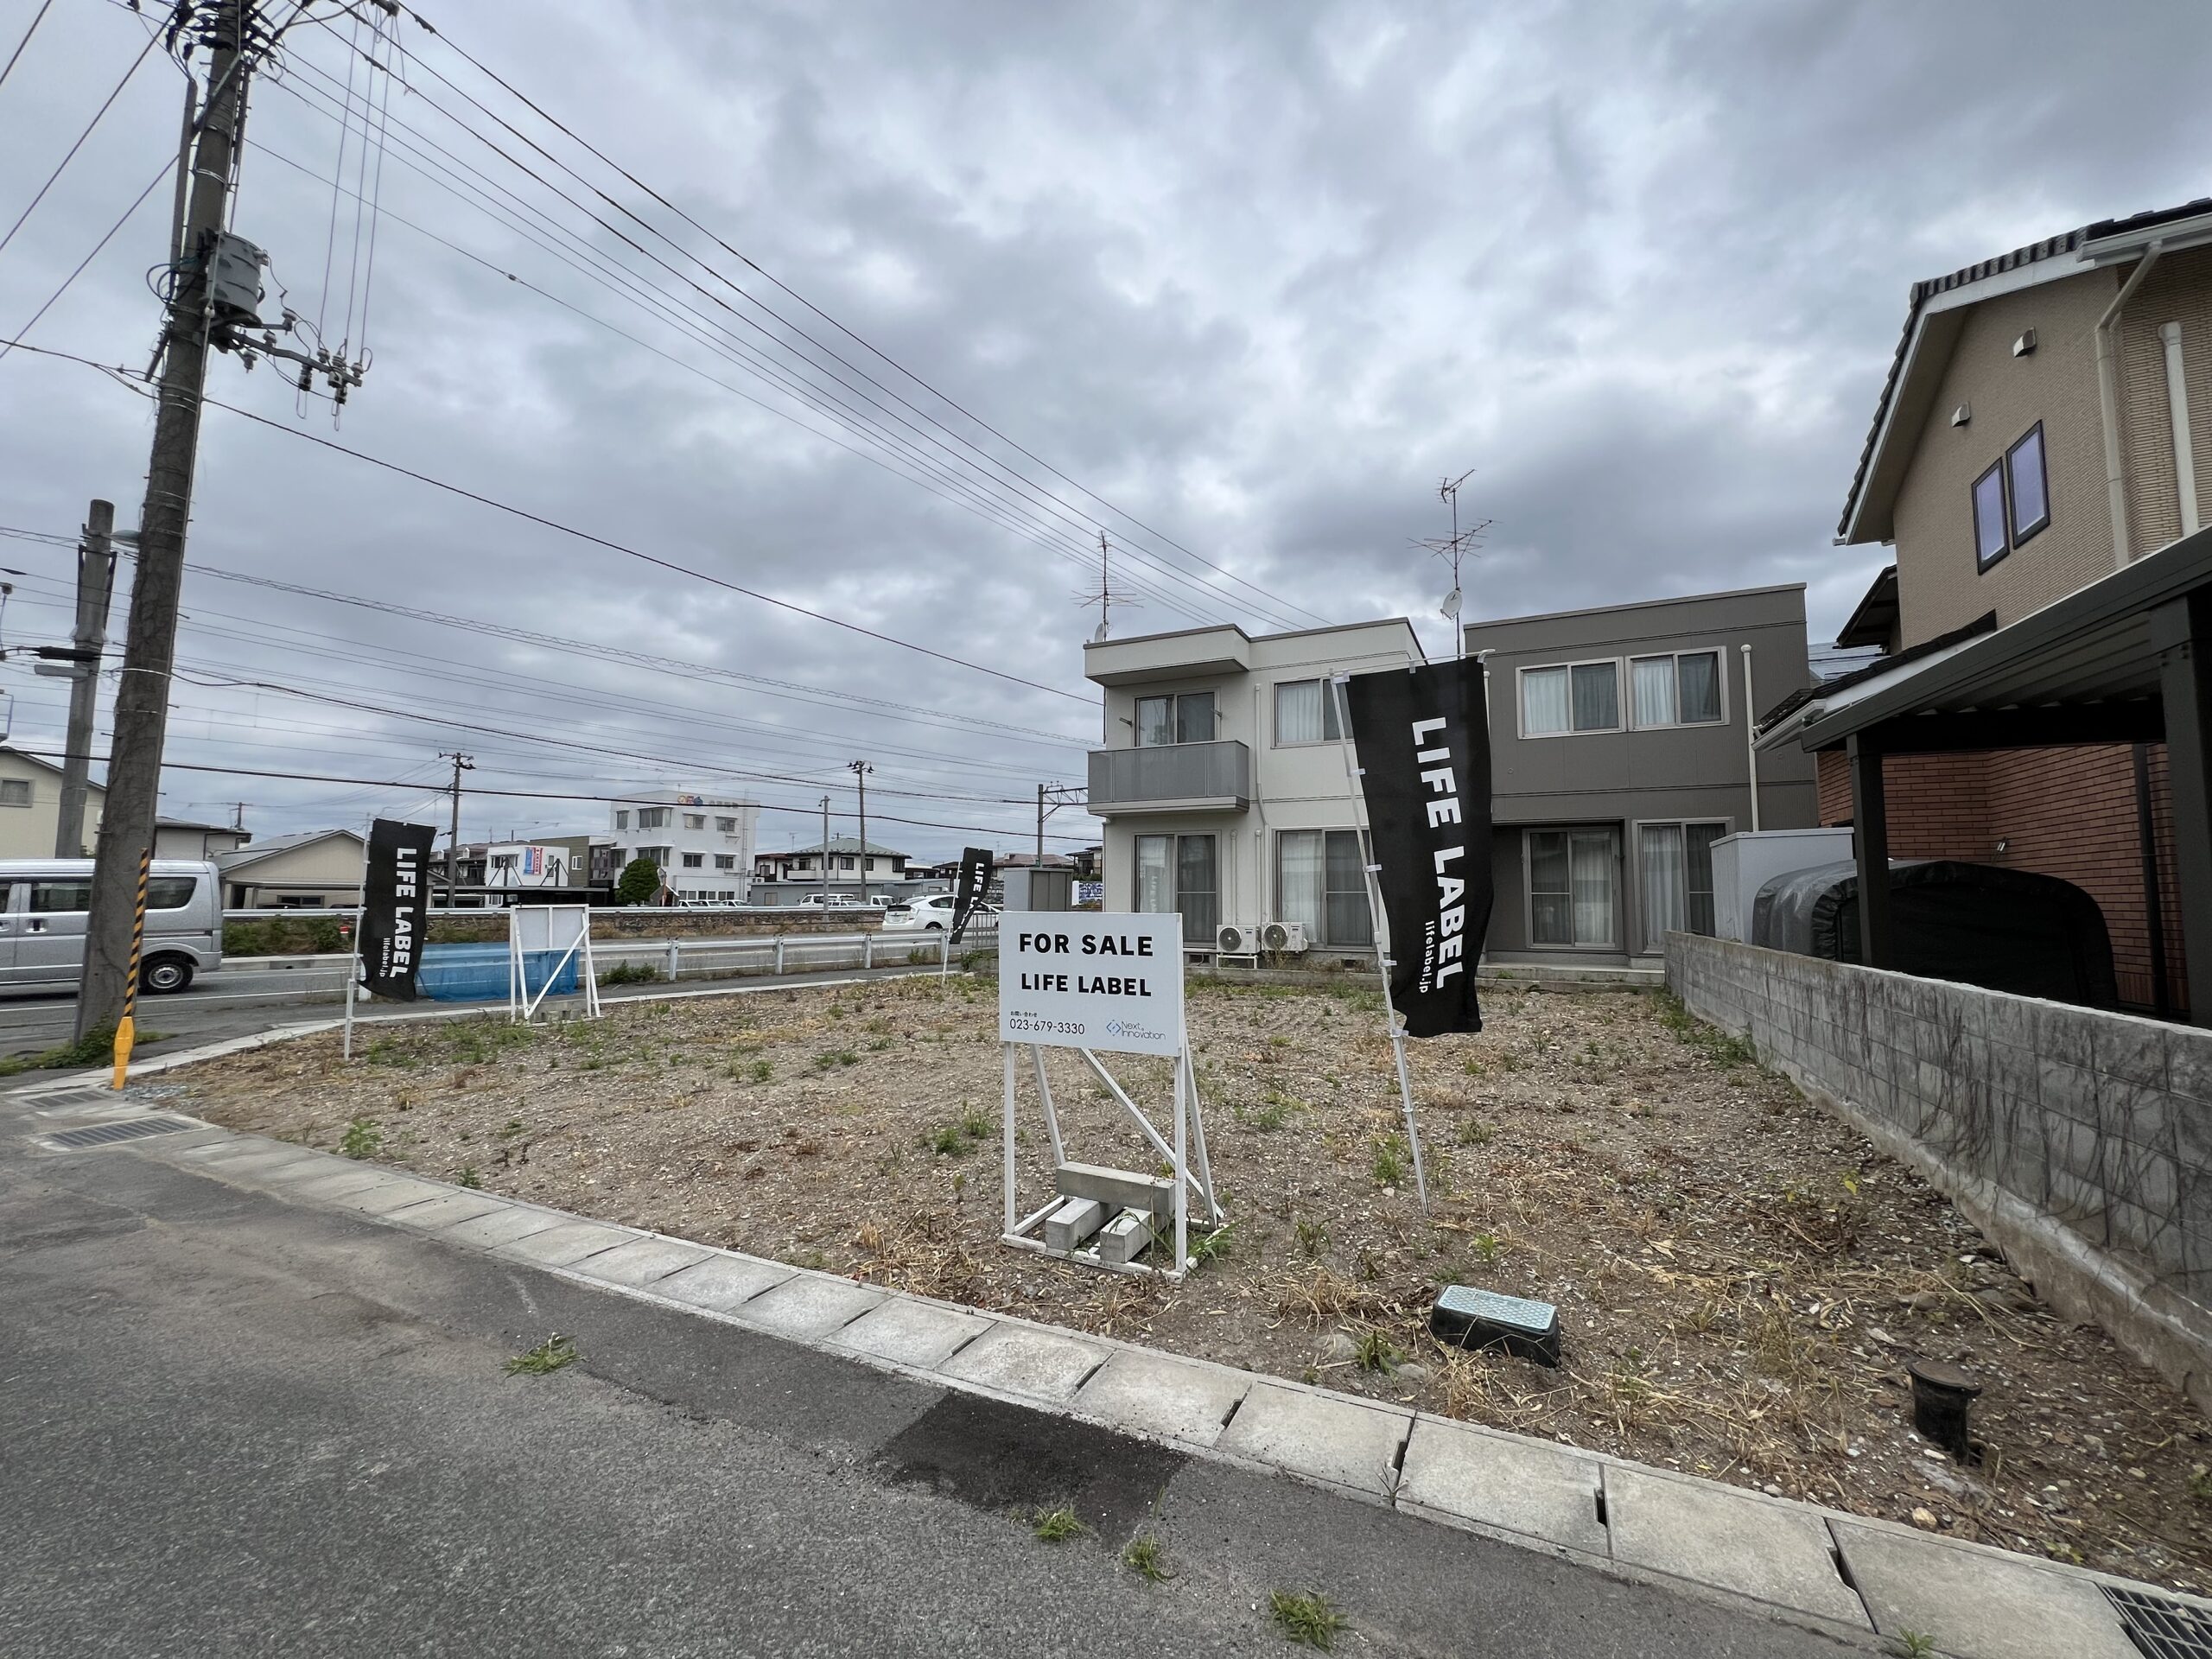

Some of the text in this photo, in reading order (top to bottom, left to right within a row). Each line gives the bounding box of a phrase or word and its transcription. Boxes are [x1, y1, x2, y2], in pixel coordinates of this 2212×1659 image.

[1412, 716, 1465, 989] LIFE LABEL
[973, 862, 985, 893] LIFE
[390, 847, 417, 978] LIFE LABEL
[379, 938, 391, 977] lifelabel.jp
[1019, 933, 1154, 957] FOR SALE
[1420, 920, 1434, 994] lifelabel.jp
[1021, 973, 1152, 997] LIFE LABEL
[1009, 1018, 1085, 1034] 023-679-3330
[1122, 1029, 1166, 1040] Innovation
